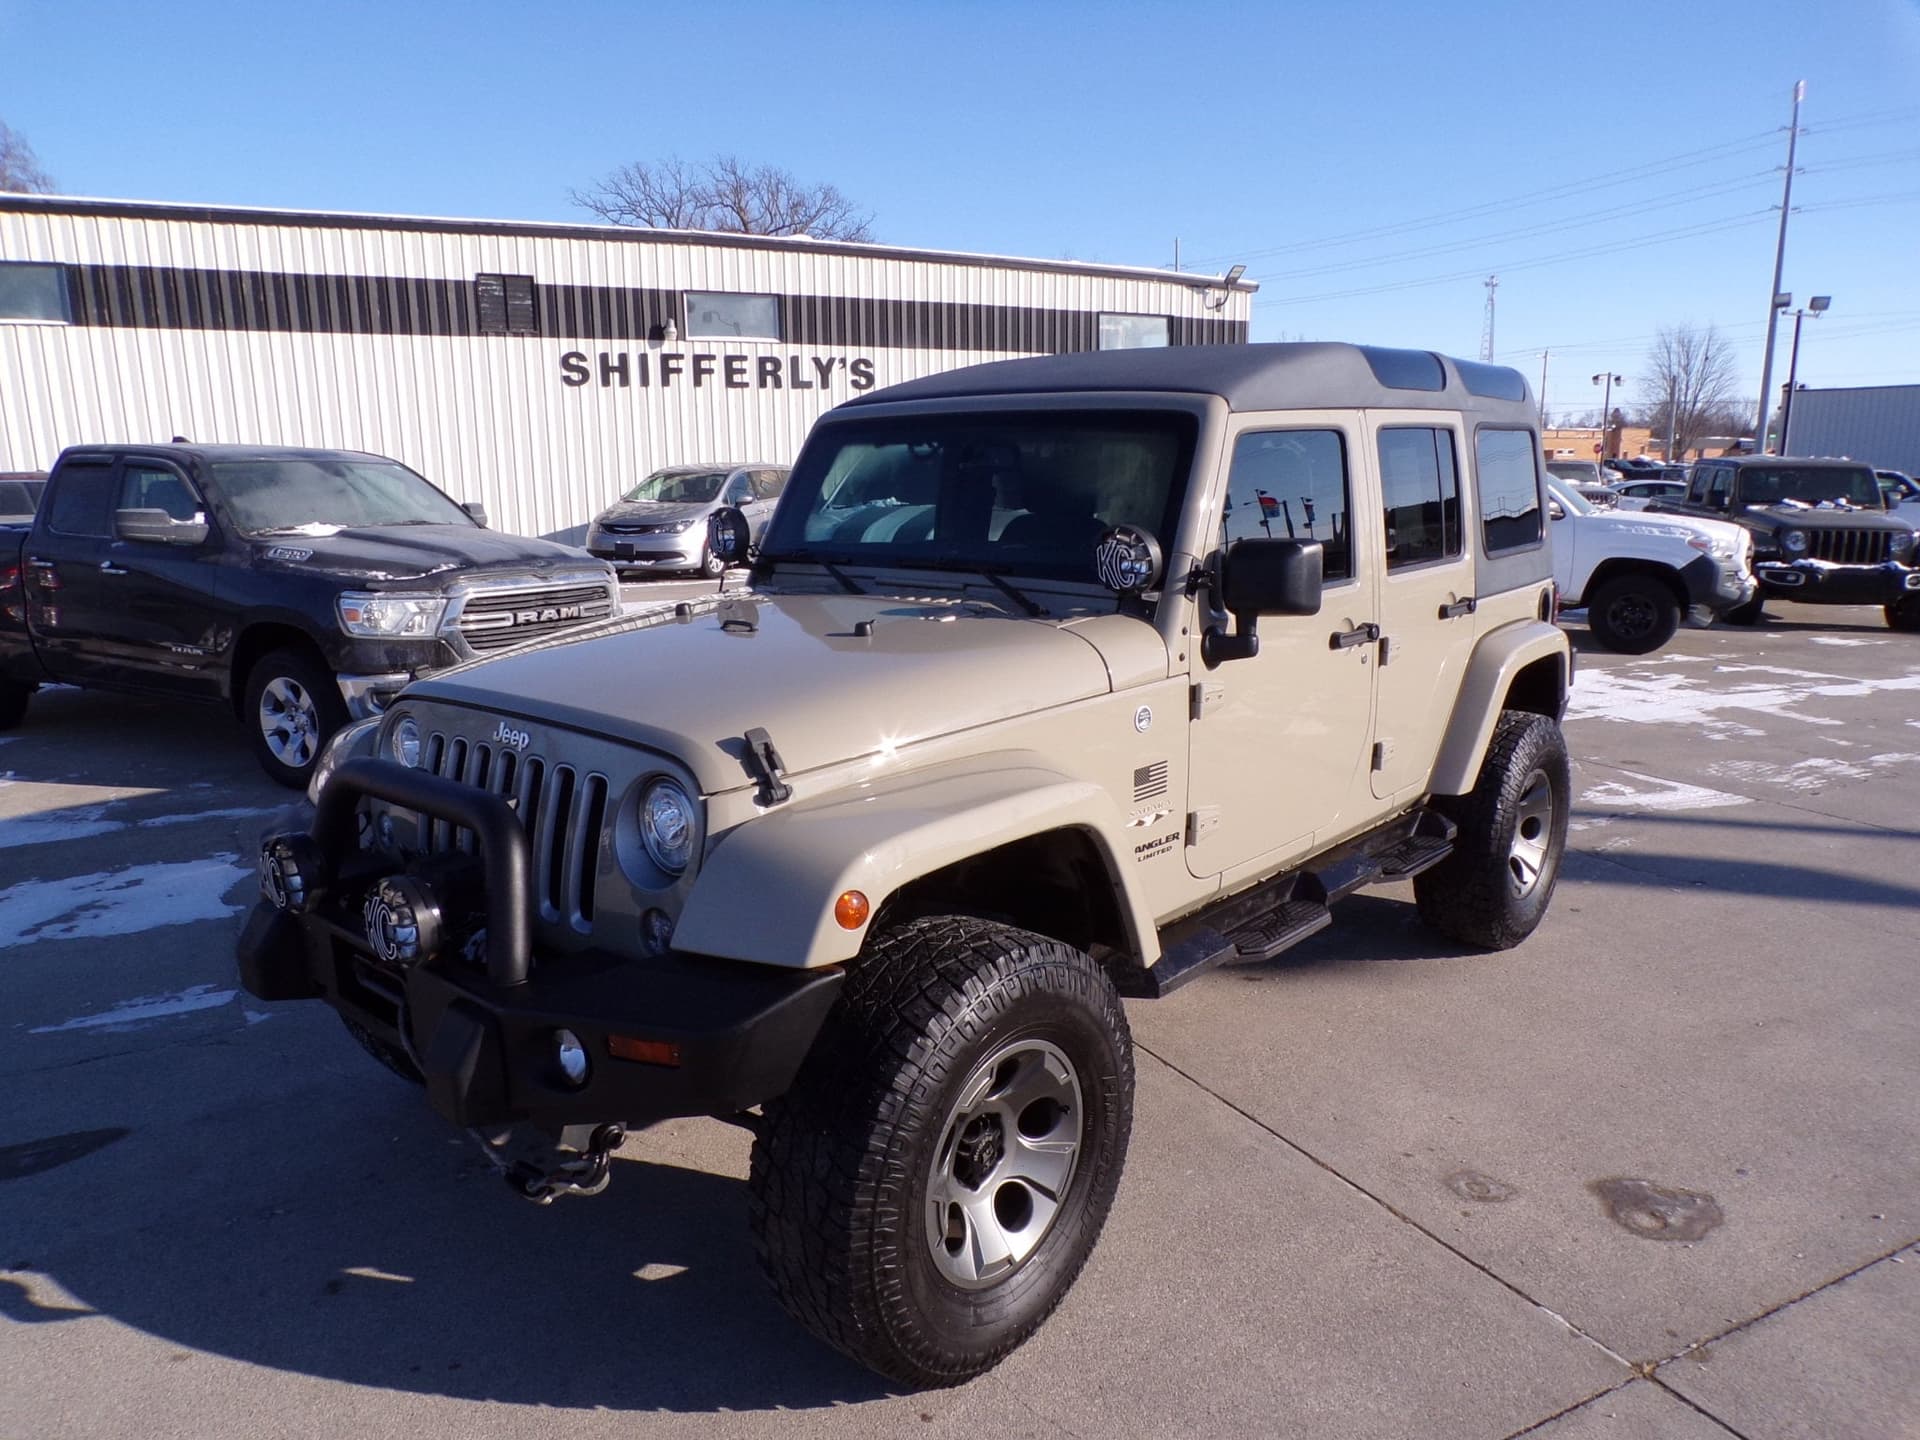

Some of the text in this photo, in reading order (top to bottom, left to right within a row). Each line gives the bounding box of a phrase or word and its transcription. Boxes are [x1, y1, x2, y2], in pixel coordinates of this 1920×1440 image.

[561, 351, 875, 390] SHIFFERLY'S
[1096, 540, 1136, 590] KC
[516, 606, 579, 624] RAM
[493, 721, 530, 752] Jeep
[1137, 845, 1173, 862] LIMITED
[364, 896, 397, 961] KC
